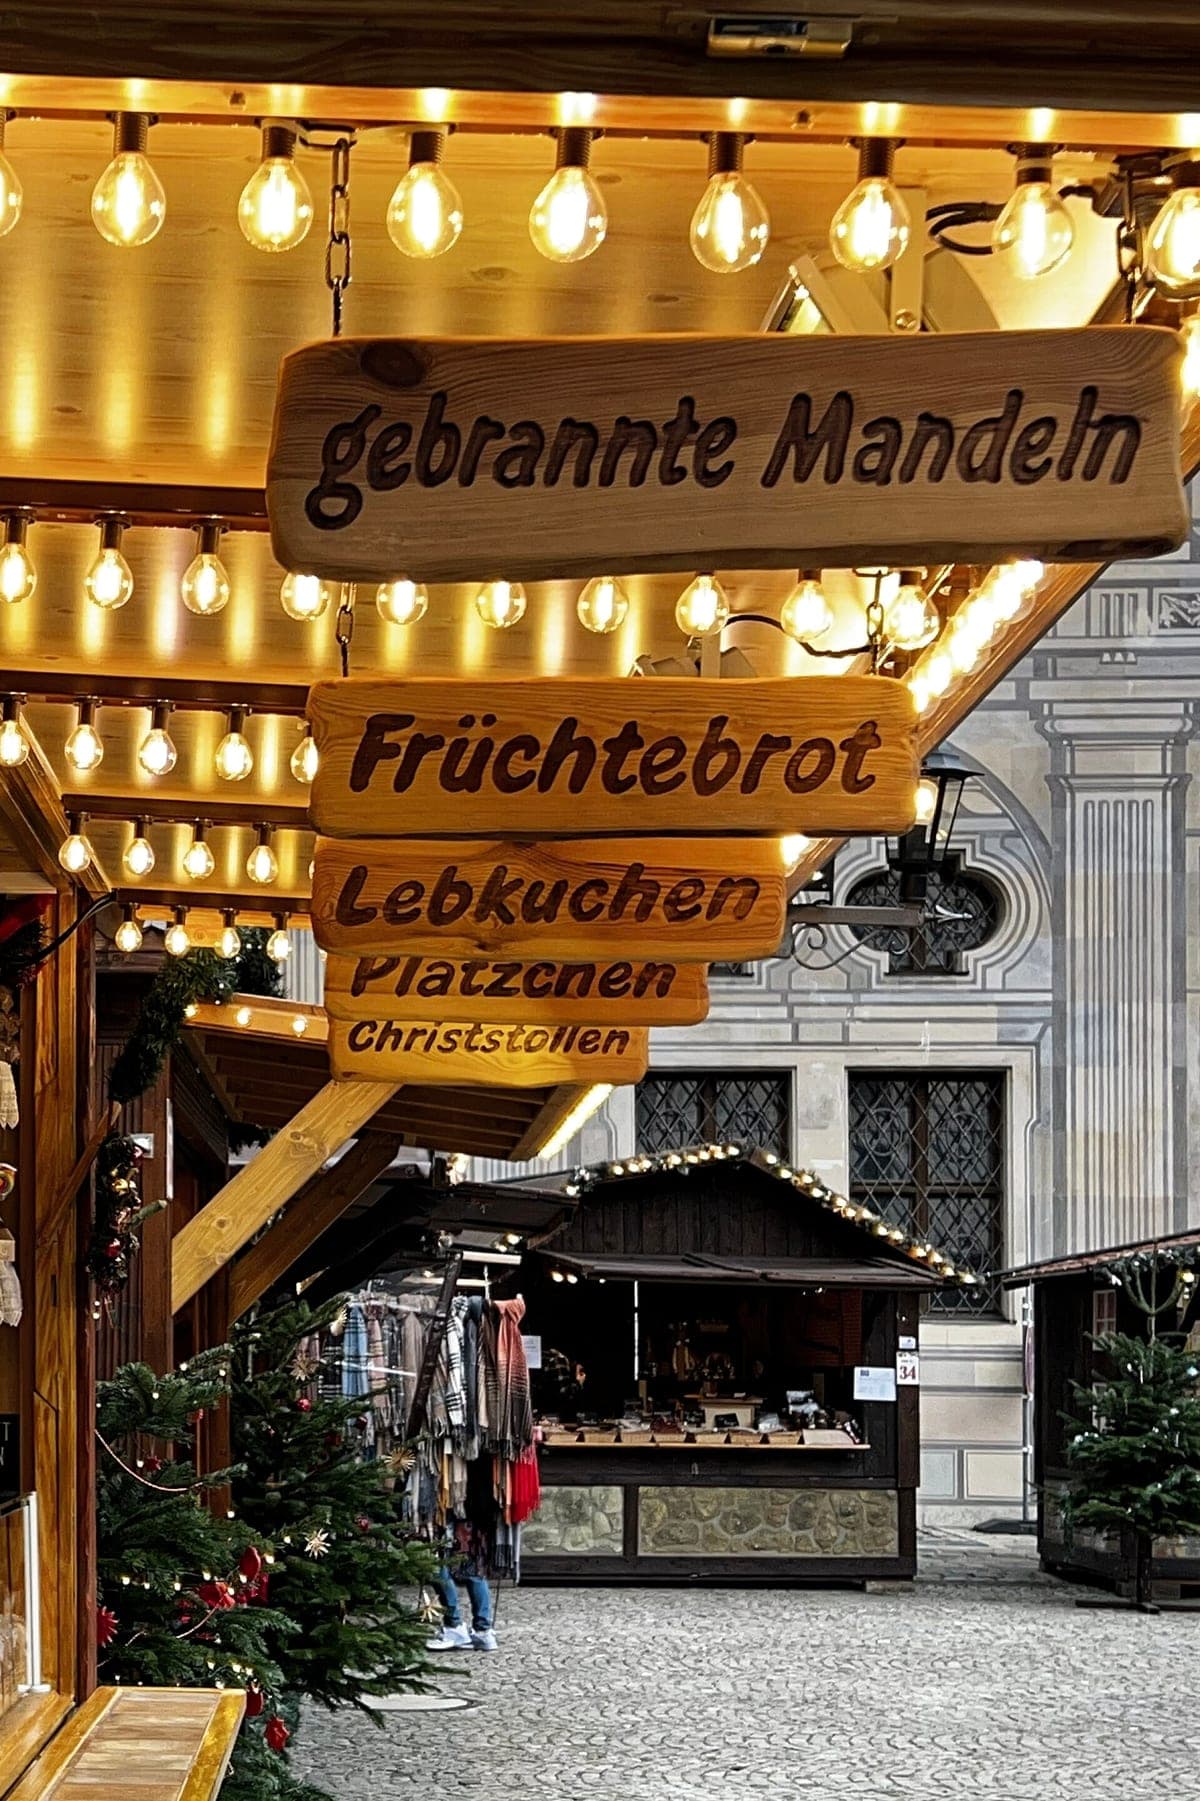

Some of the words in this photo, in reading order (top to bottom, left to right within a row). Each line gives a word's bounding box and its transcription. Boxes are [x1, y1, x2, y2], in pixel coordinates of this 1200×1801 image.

[304, 391, 738, 531] gebrannte
[761, 384, 1151, 488] Mandeln
[349, 713, 883, 796] Früchtebrot
[334, 863, 761, 927] Lebkuchen
[347, 1020, 631, 1054] Christstollen
[899, 1365, 916, 1380] 34
